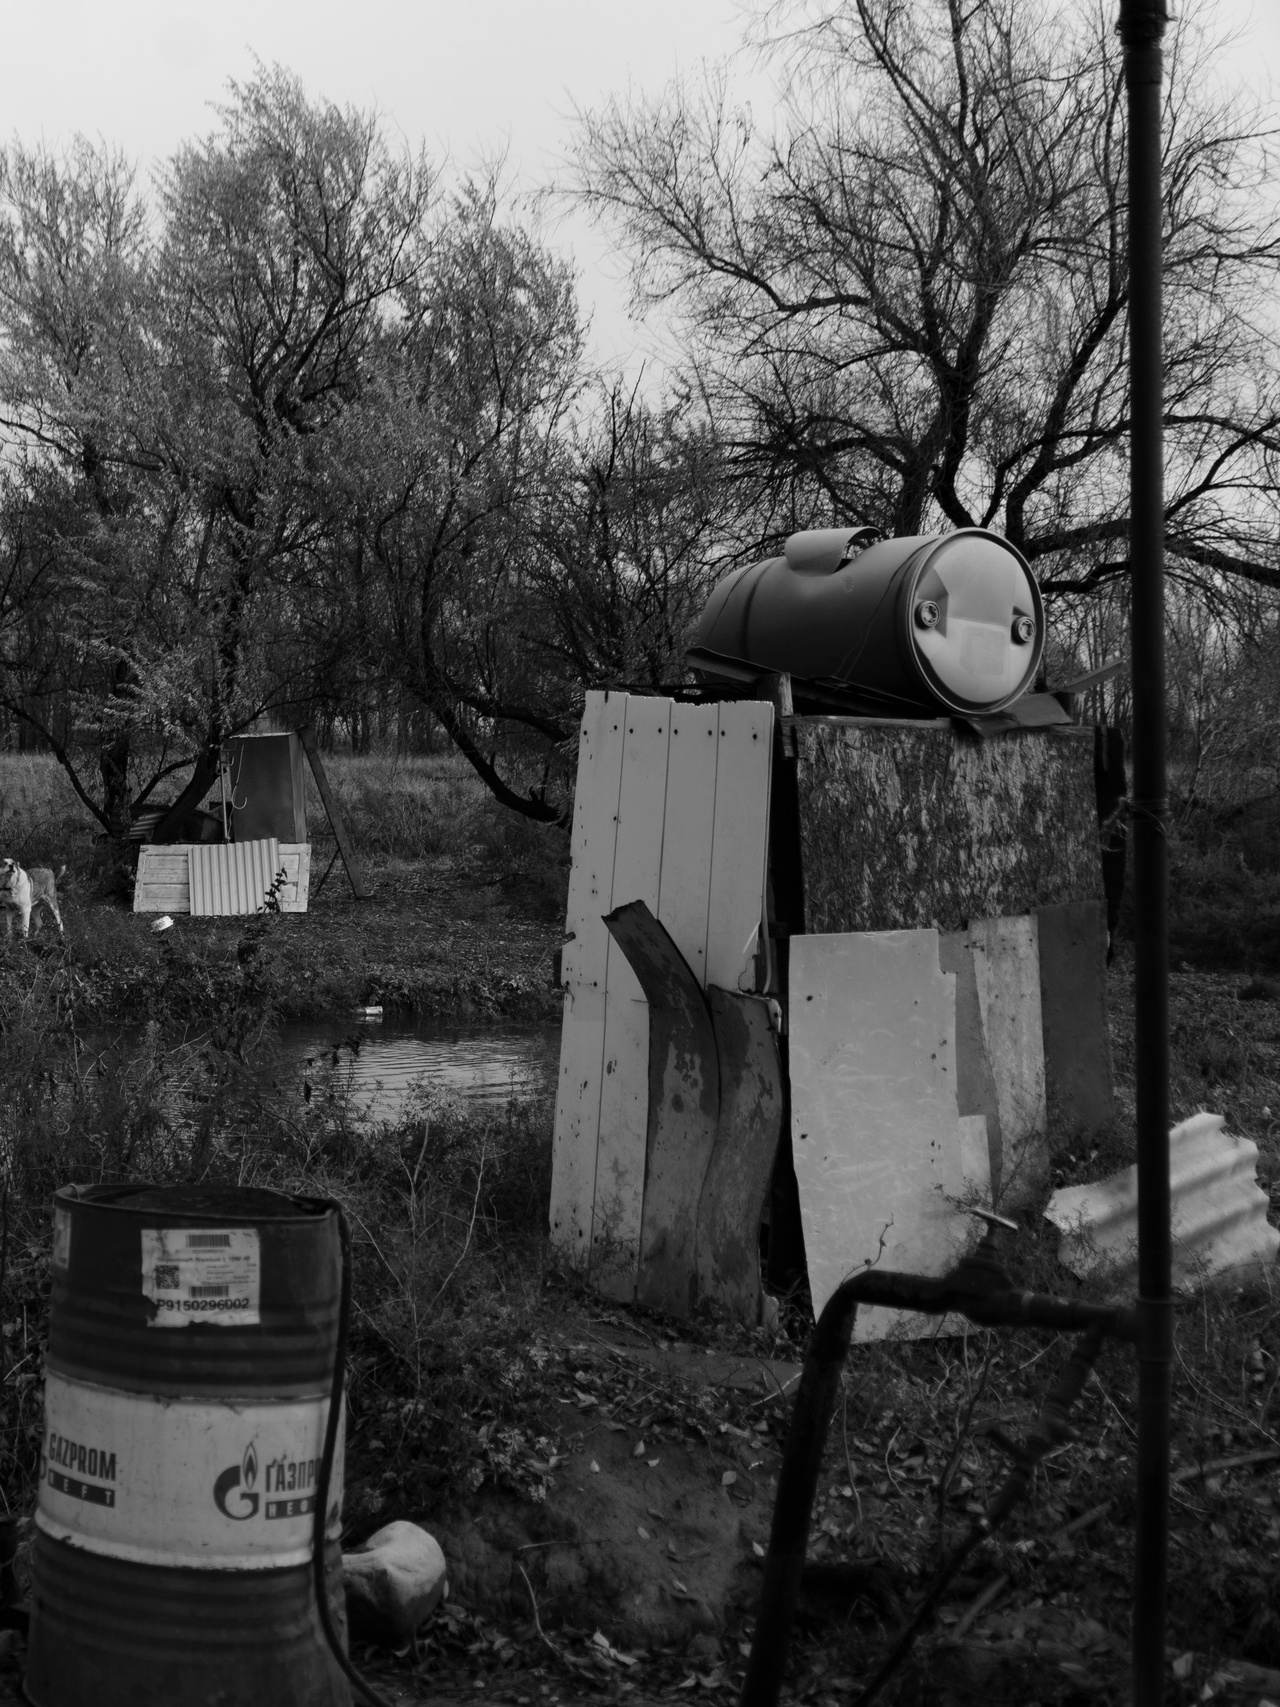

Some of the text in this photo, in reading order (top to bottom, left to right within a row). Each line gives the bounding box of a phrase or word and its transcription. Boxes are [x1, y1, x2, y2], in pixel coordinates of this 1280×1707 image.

[156, 1298, 250, 1311] P9150296002
[49, 1433, 116, 1482] GAZPROM
[265, 1457, 324, 1493] ГАЗПРО
[268, 1499, 309, 1518] НЕФ
